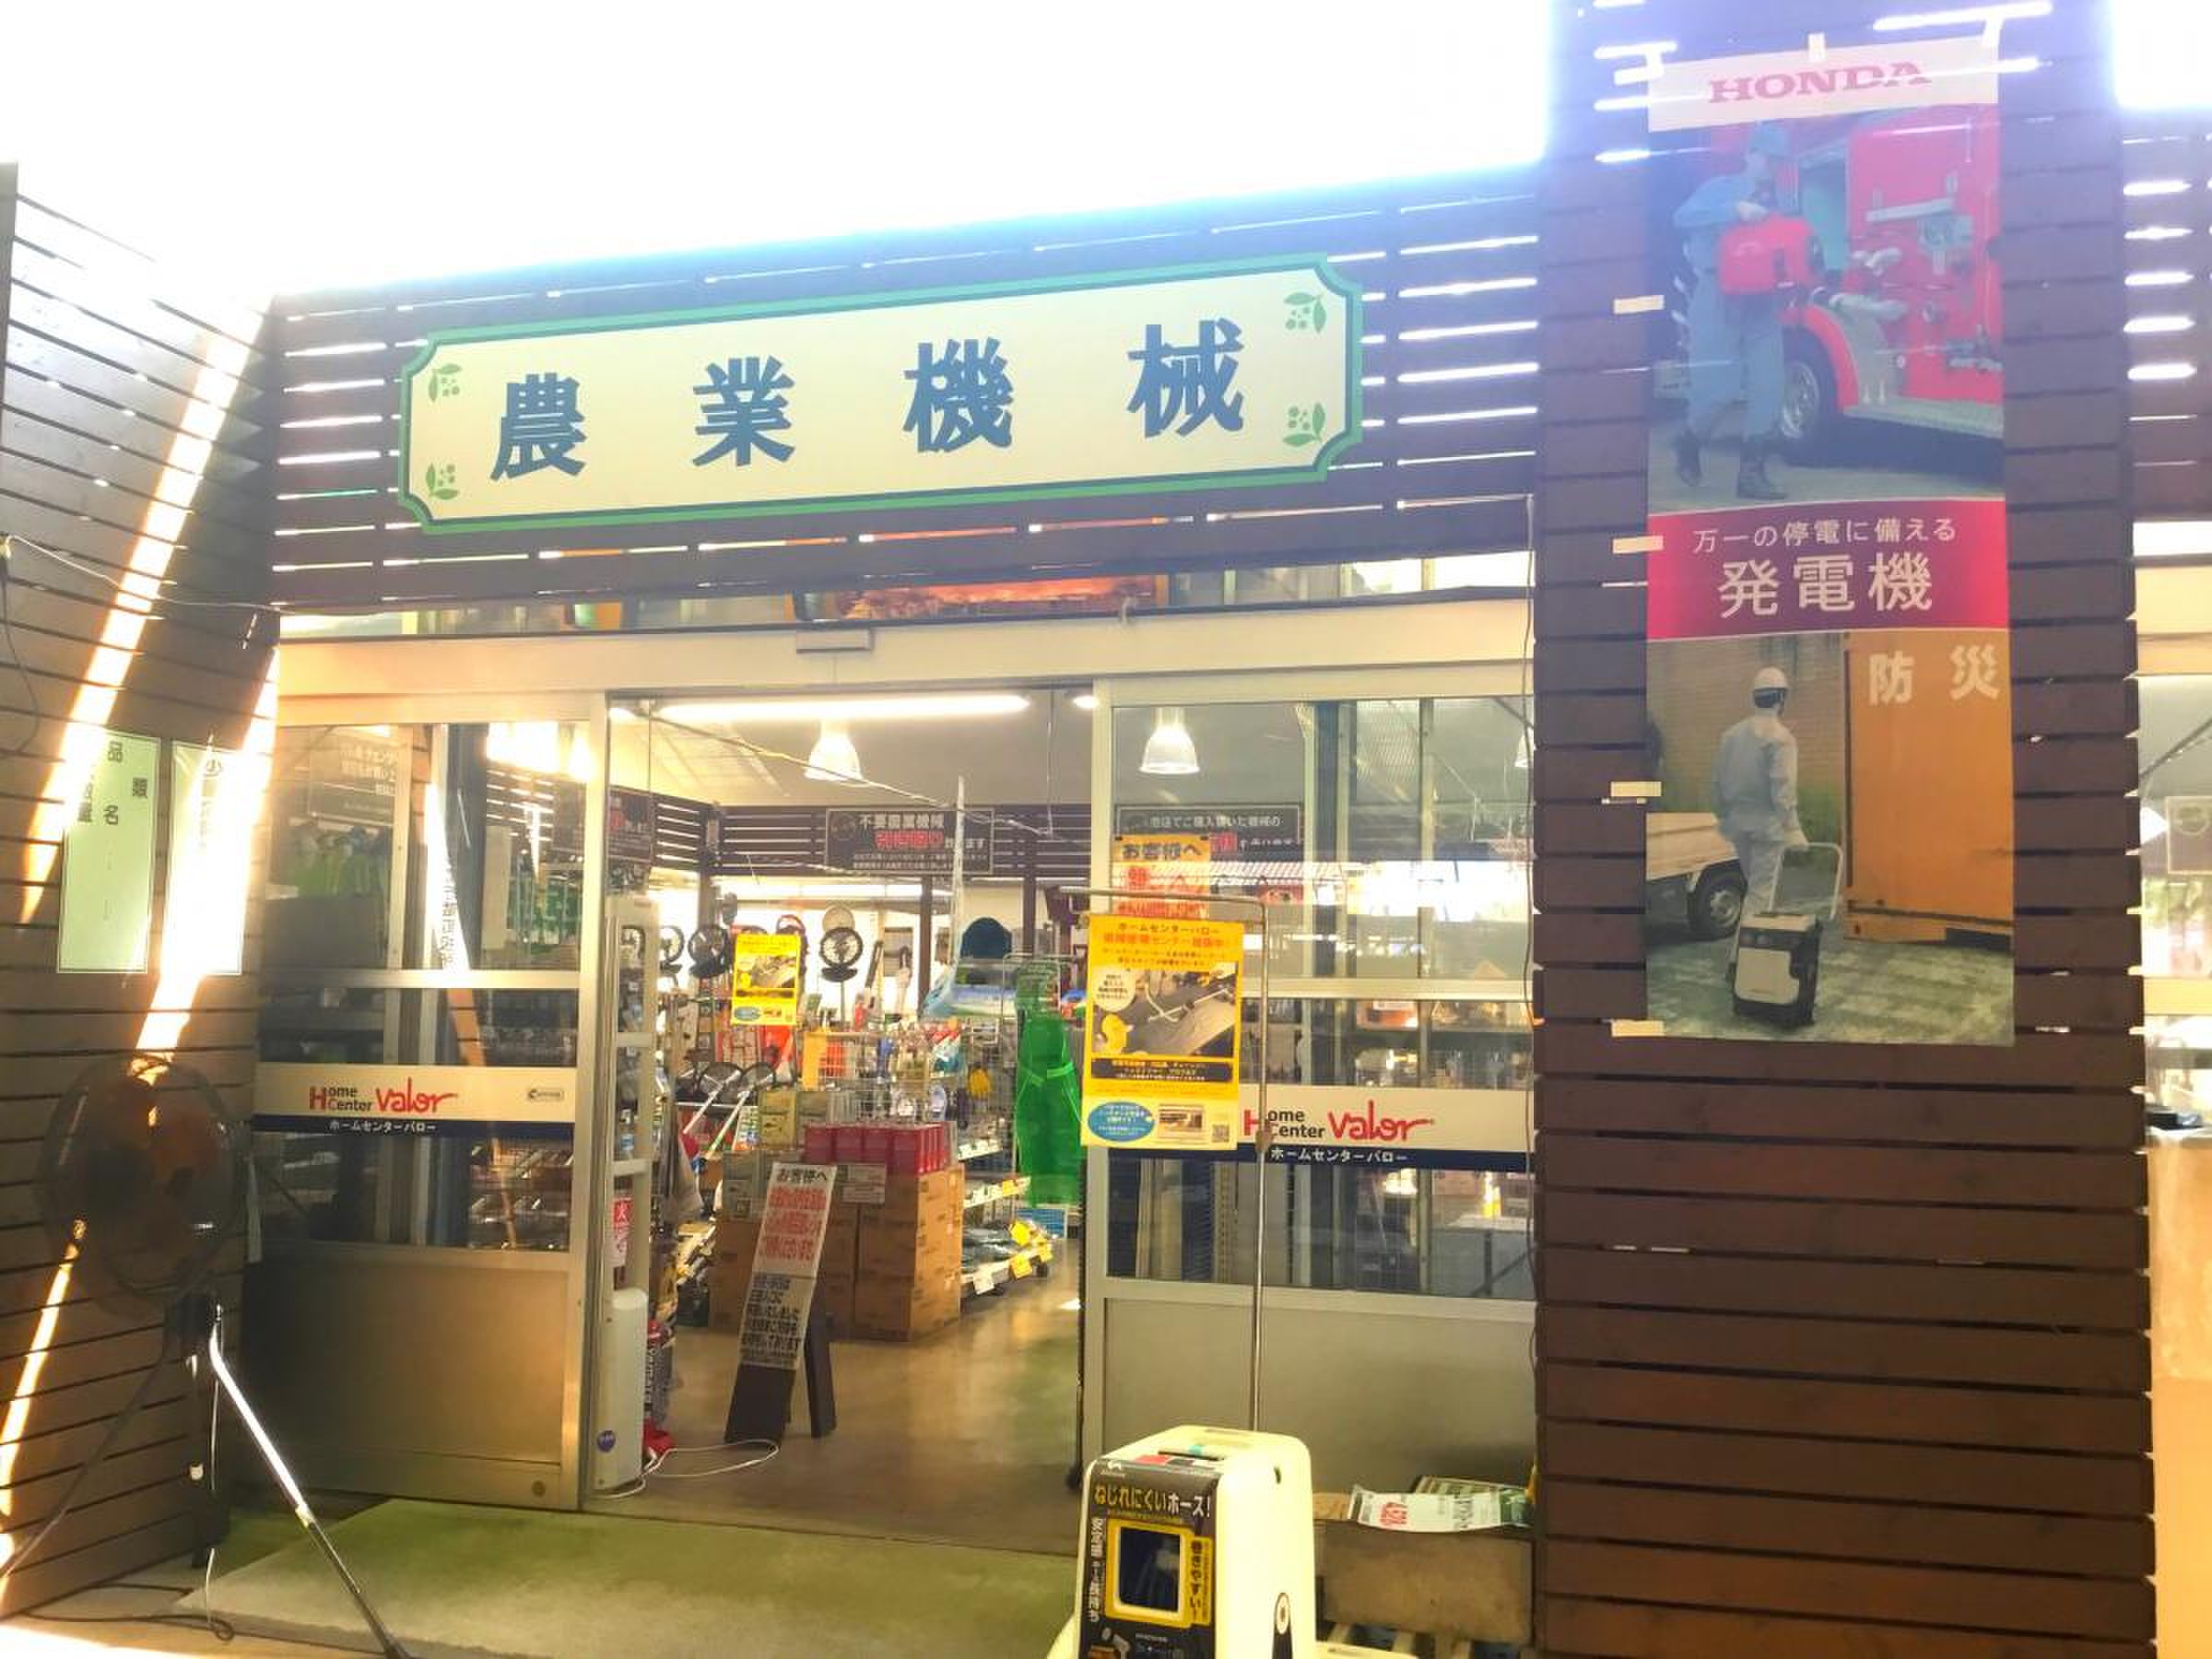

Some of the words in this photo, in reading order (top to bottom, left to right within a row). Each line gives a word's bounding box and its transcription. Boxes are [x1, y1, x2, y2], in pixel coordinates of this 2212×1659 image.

[1709, 61, 1933, 103] HONDA
[489, 316, 1245, 482] 農業機械
[1692, 518, 1956, 553] 万一の停電に備える
[1717, 551, 1933, 618] 発電機
[1869, 644, 2001, 706] 防災
[310, 1086, 359, 1111] Home
[330, 1121, 437, 1135] ホームセンターバロー
[1271, 1147, 1407, 1163] ホームセンターバロー
